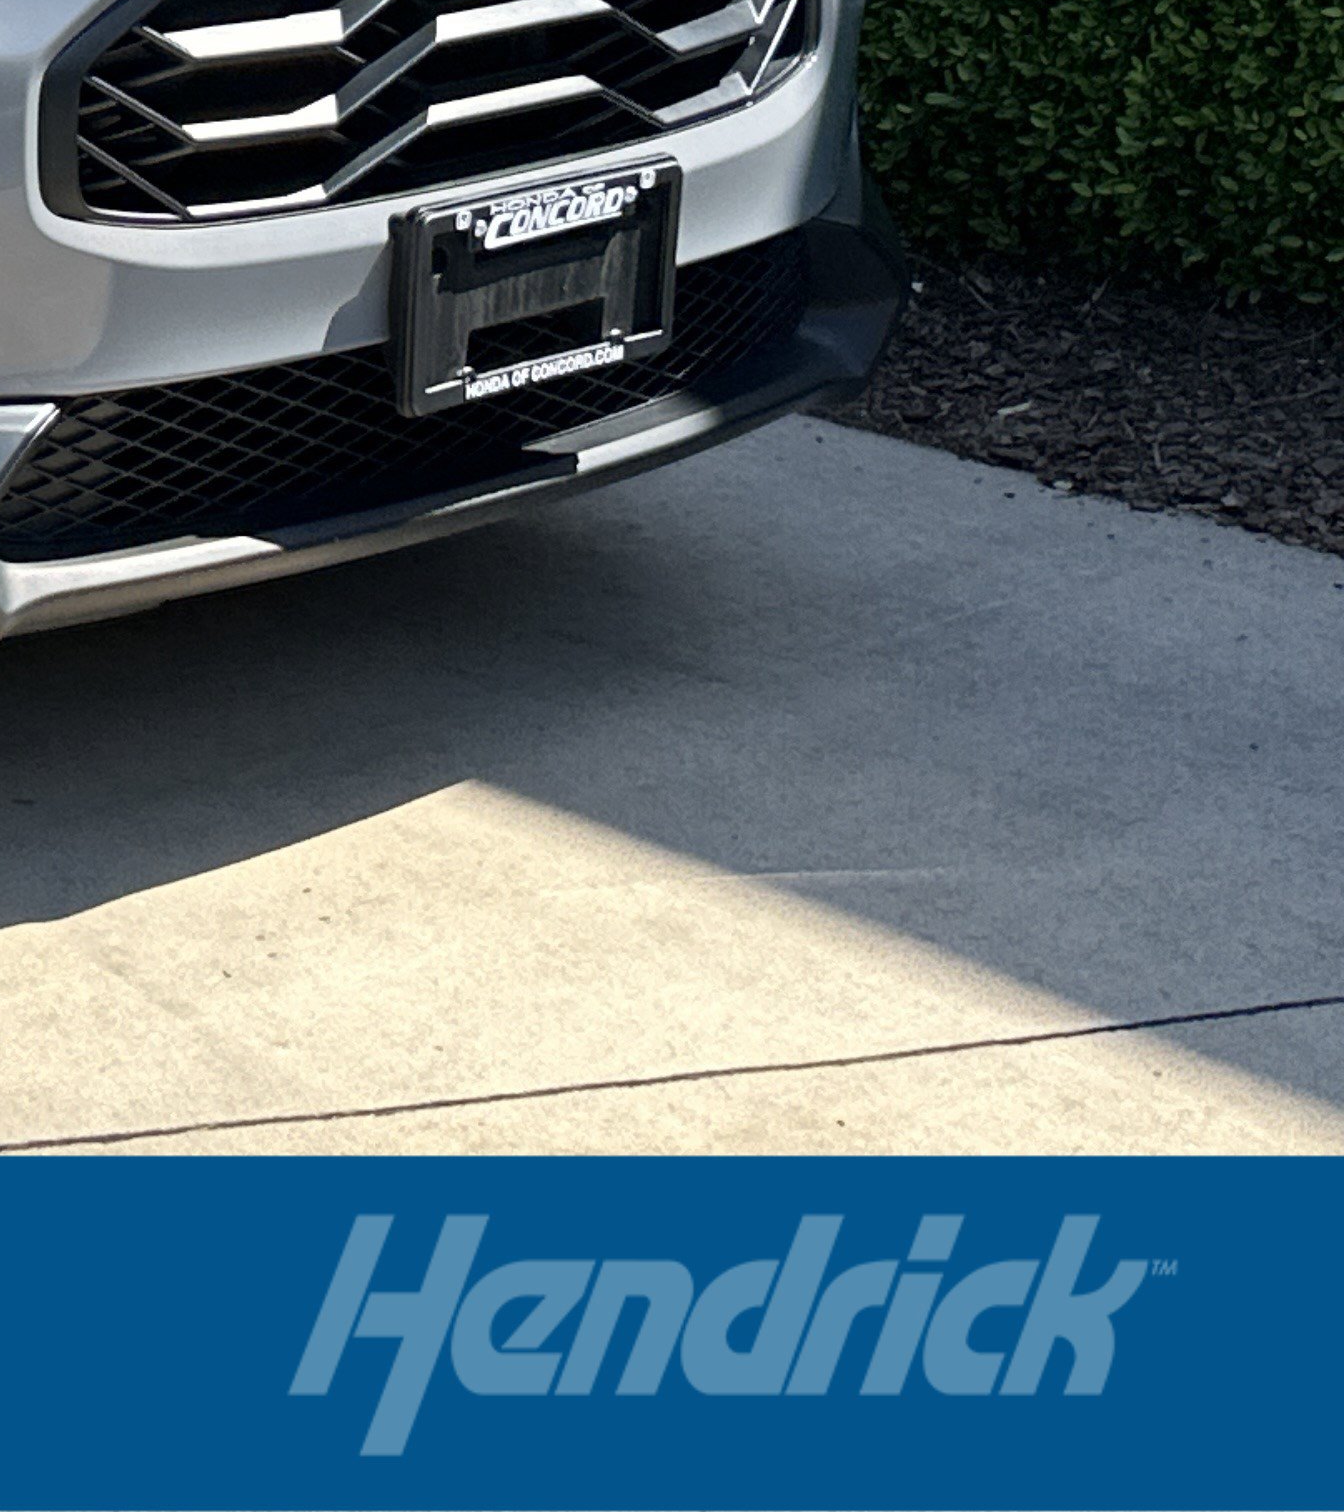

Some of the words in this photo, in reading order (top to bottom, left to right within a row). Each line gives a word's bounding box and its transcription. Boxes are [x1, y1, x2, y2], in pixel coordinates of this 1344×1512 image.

[484, 186, 625, 249] CONCORD
[490, 186, 577, 215] HONDA
[465, 373, 510, 400] HONDA
[511, 367, 531, 387] OF
[531, 344, 625, 382] CONCORD.COM
